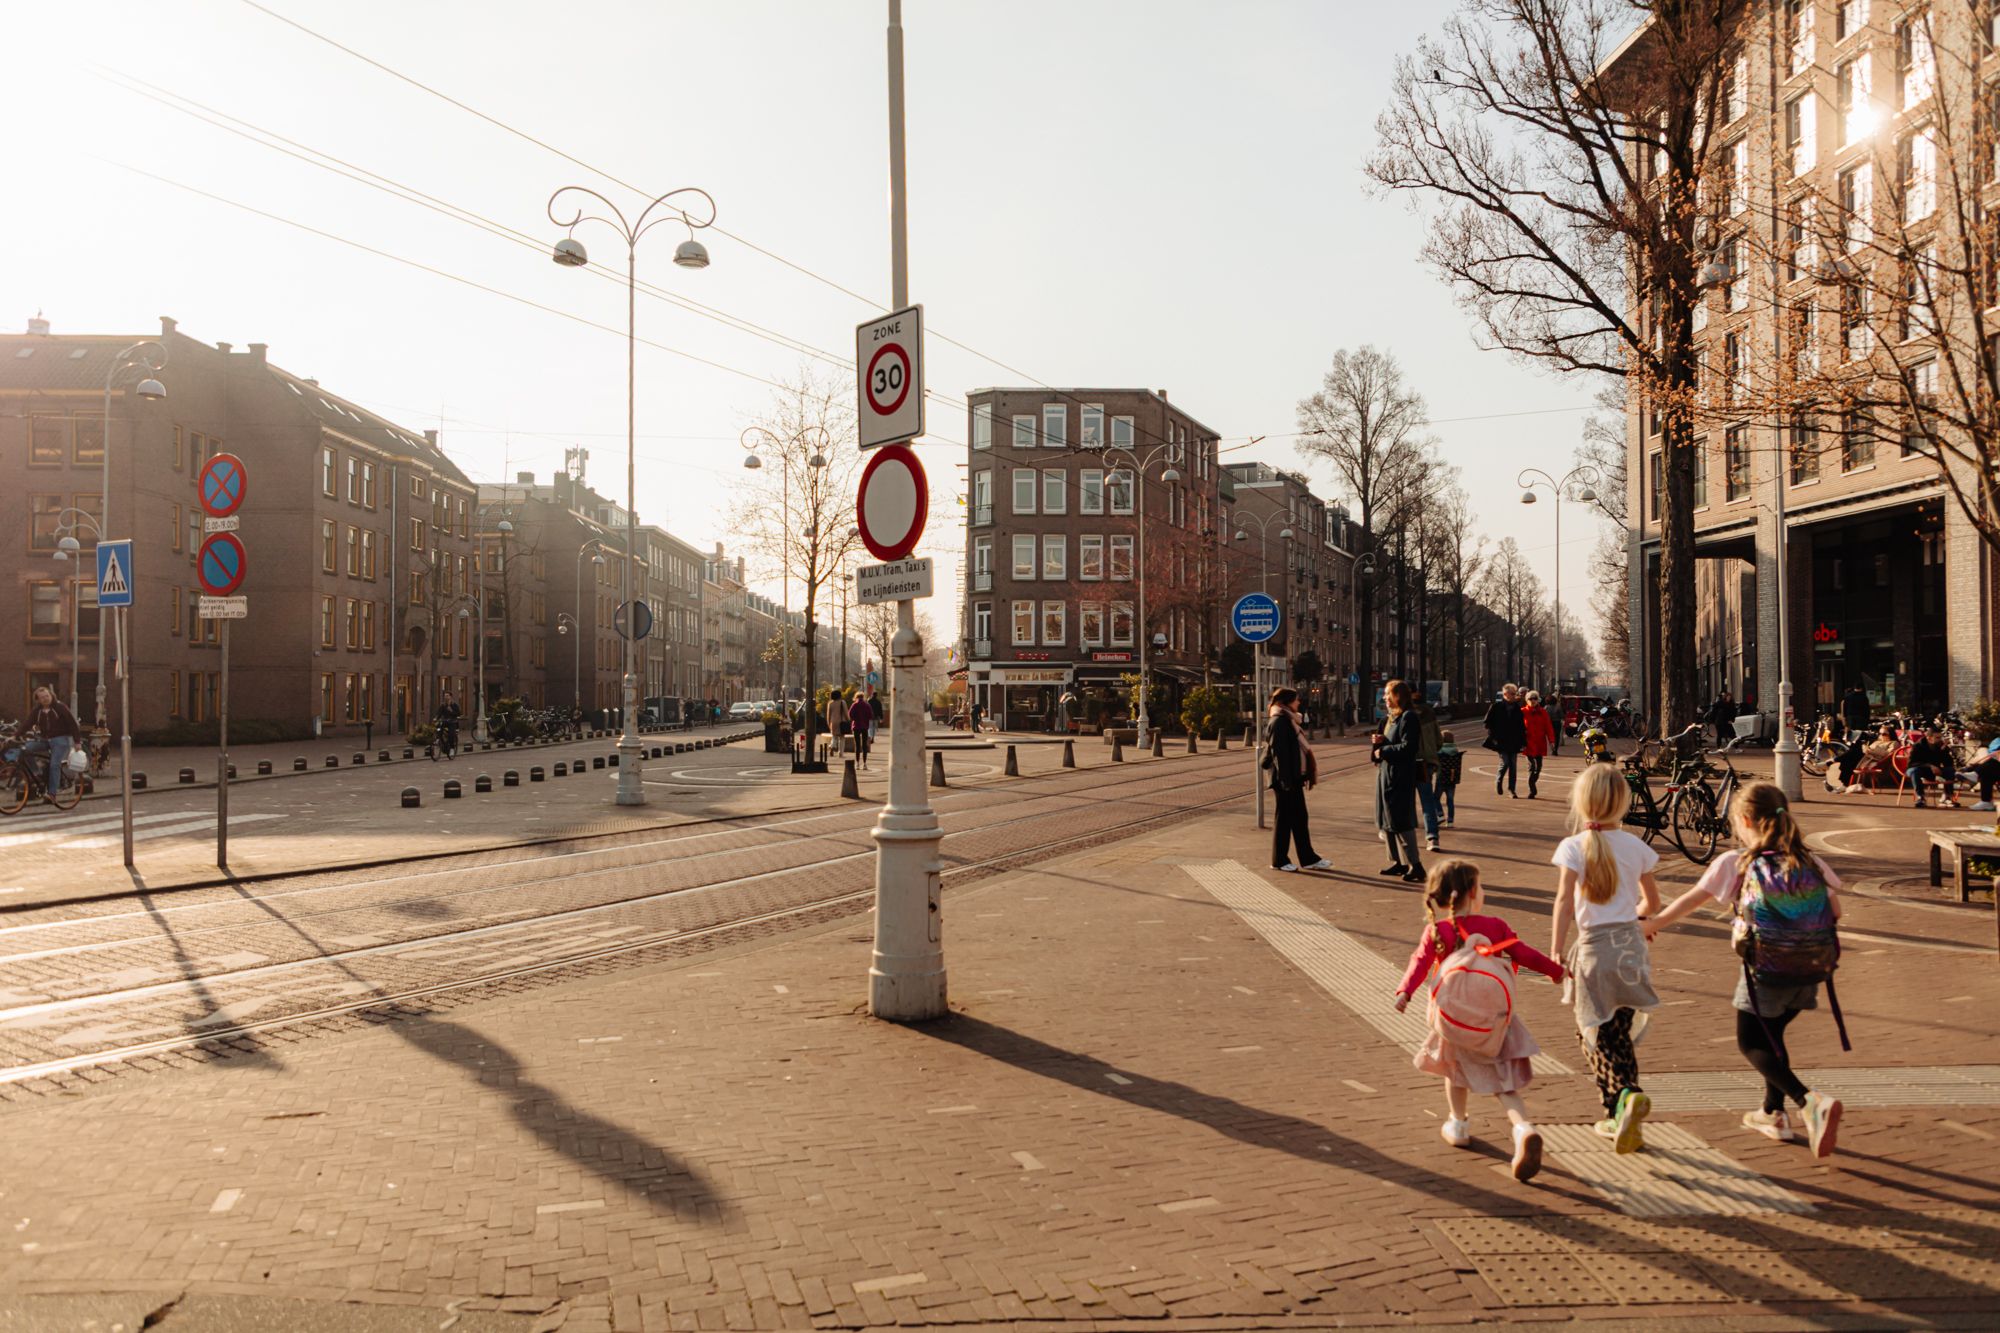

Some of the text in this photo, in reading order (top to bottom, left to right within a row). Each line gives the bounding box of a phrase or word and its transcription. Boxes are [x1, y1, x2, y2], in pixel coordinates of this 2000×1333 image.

[873, 321, 901, 341] ZONE
[874, 364, 902, 394] 30
[883, 564, 904, 576] Tram,
[863, 582, 920, 598] en Lijndiensten
[1097, 653, 1127, 661] Heineken
